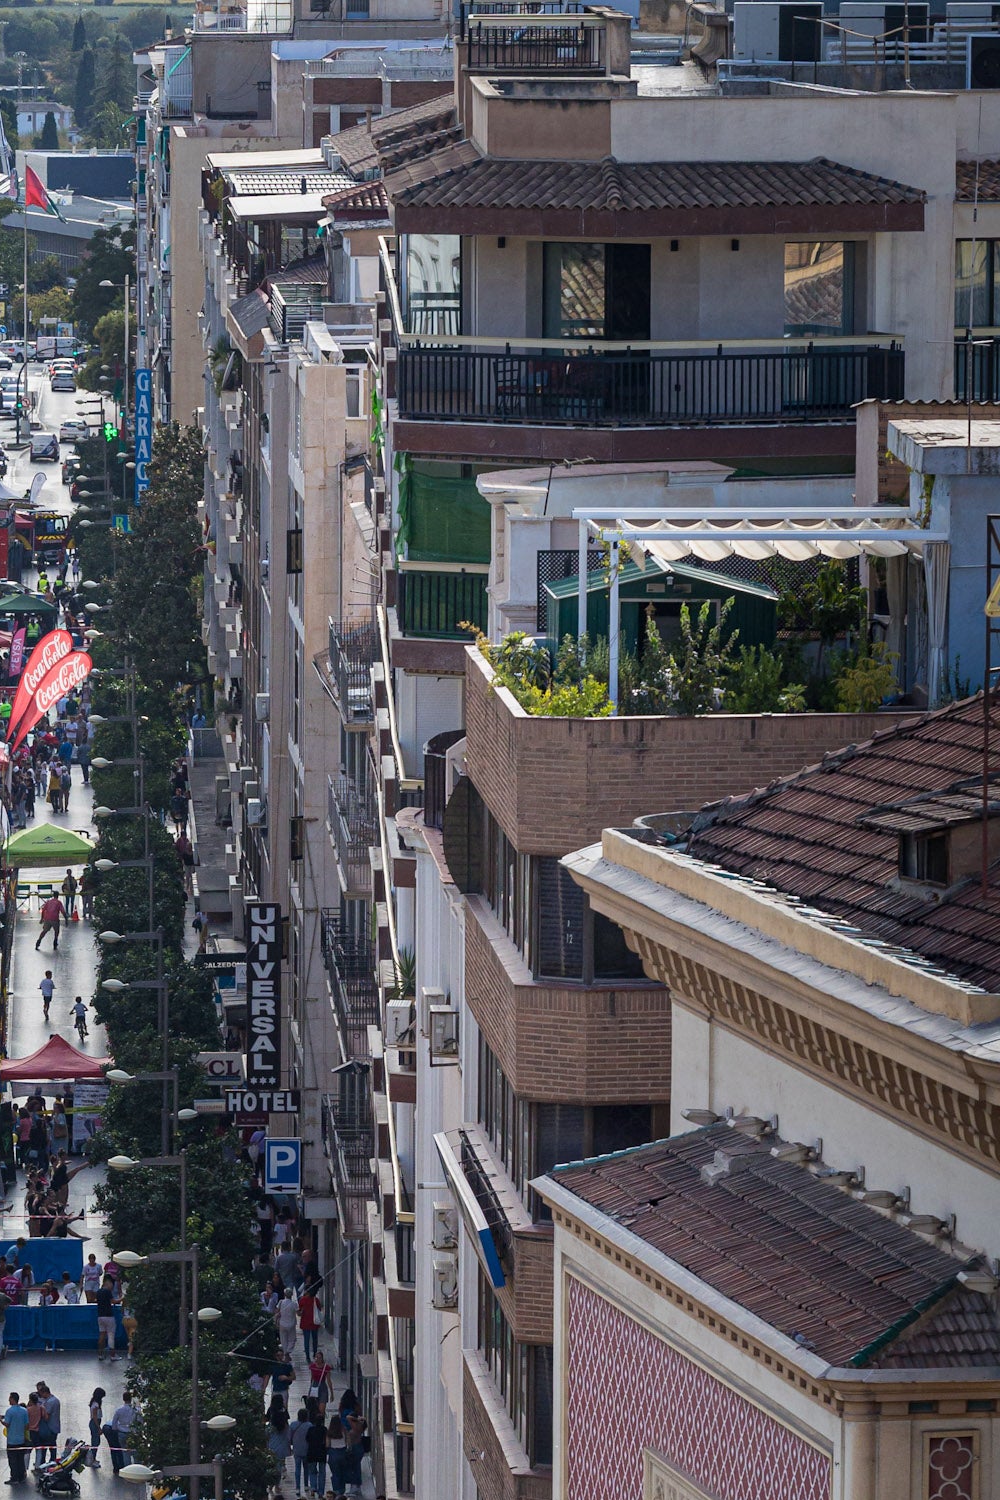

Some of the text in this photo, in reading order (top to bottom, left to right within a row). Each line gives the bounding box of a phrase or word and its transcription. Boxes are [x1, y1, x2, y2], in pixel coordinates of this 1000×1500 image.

[36, 654, 87, 713] Coca-Cola
[250, 907, 276, 1071] UNIVERSAL
[228, 1092, 297, 1112] HOTEL
[269, 1145, 296, 1179] P
